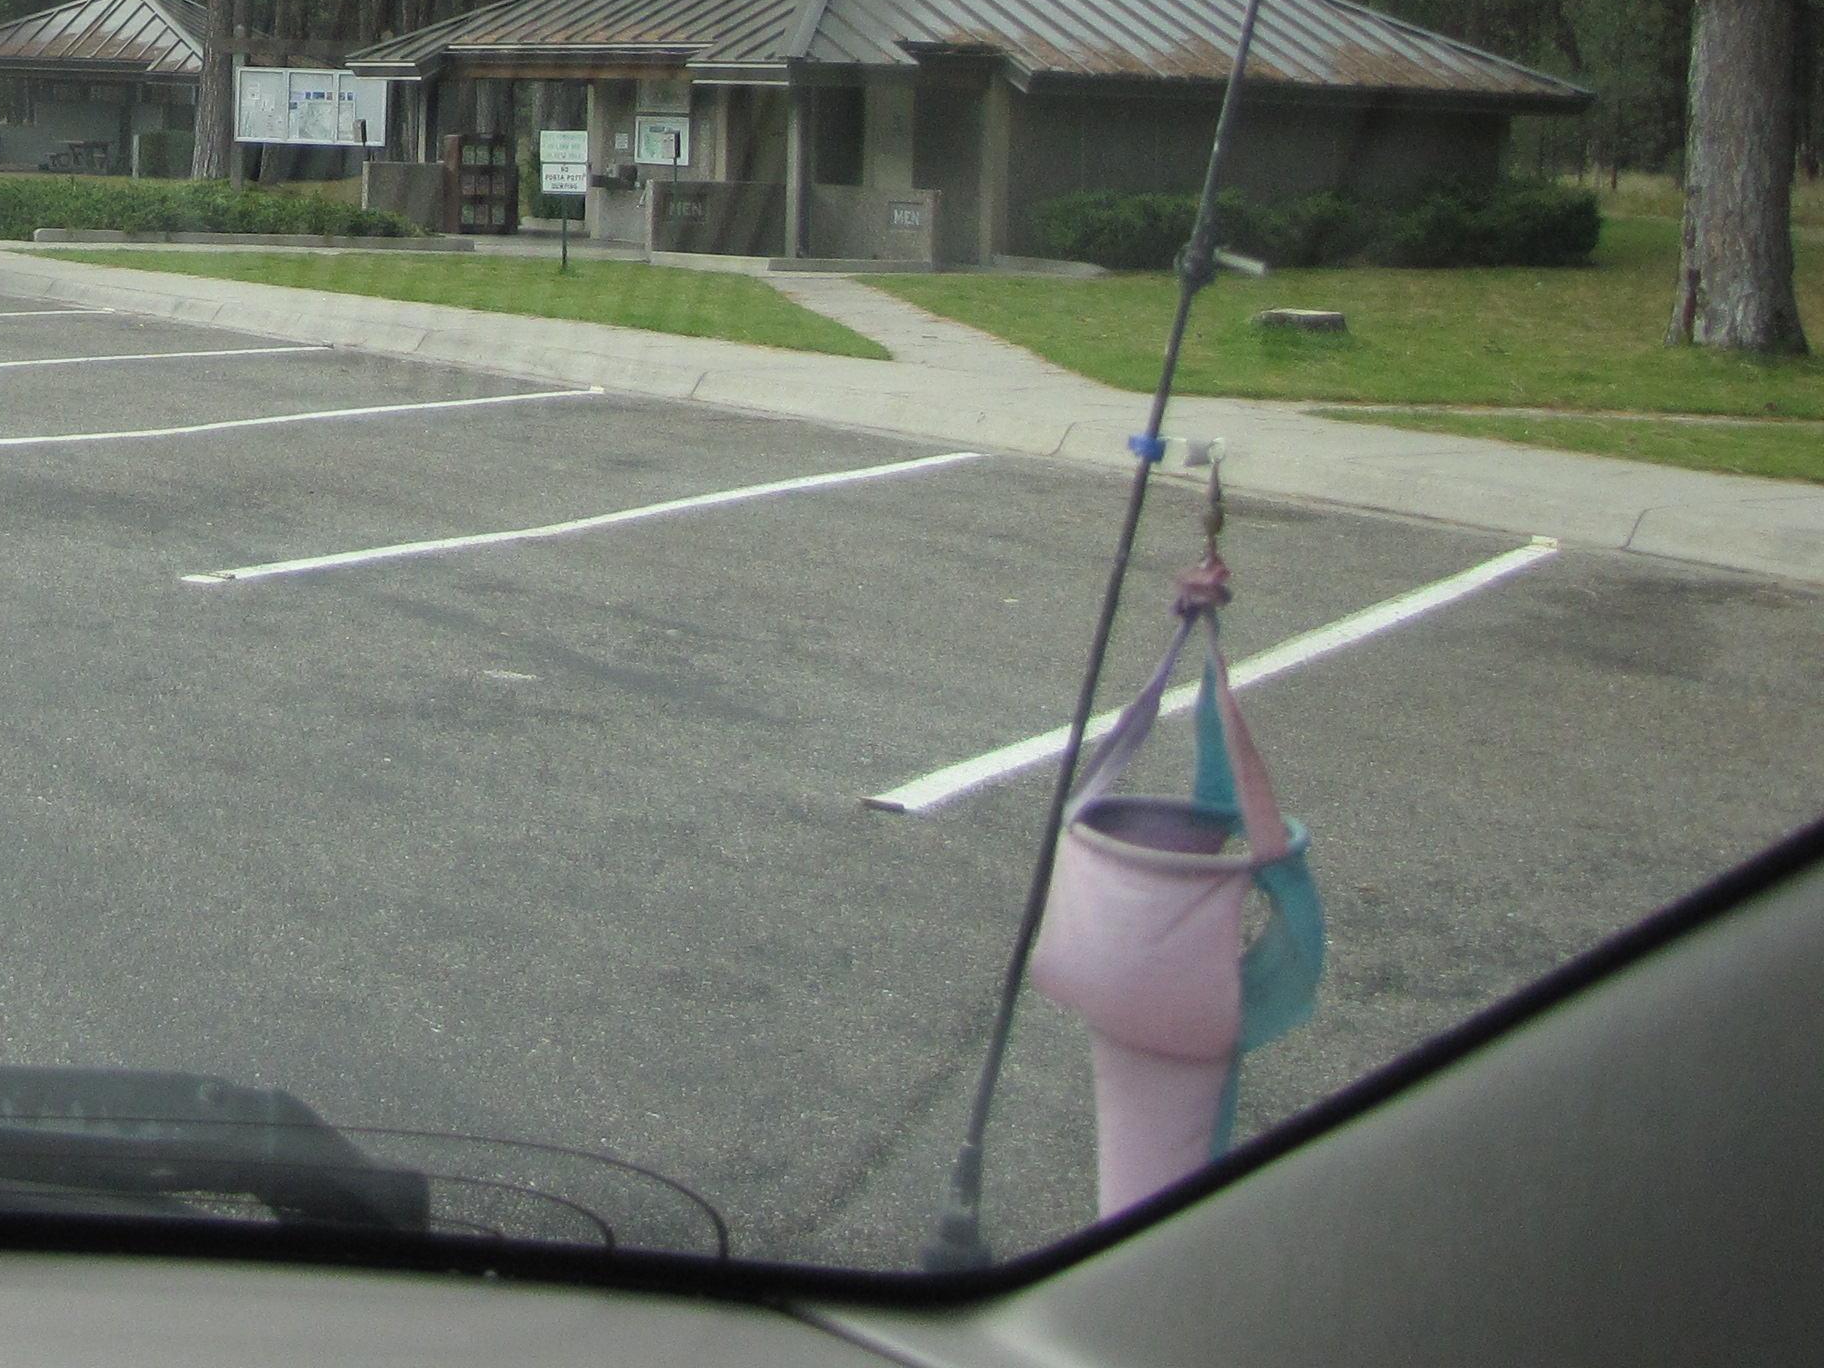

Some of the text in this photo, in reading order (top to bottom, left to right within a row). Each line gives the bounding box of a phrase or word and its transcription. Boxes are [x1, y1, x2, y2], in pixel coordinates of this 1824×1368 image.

[551, 182, 578, 190] DUMPING
[669, 201, 703, 216] MEN
[893, 209, 920, 226] MEN
